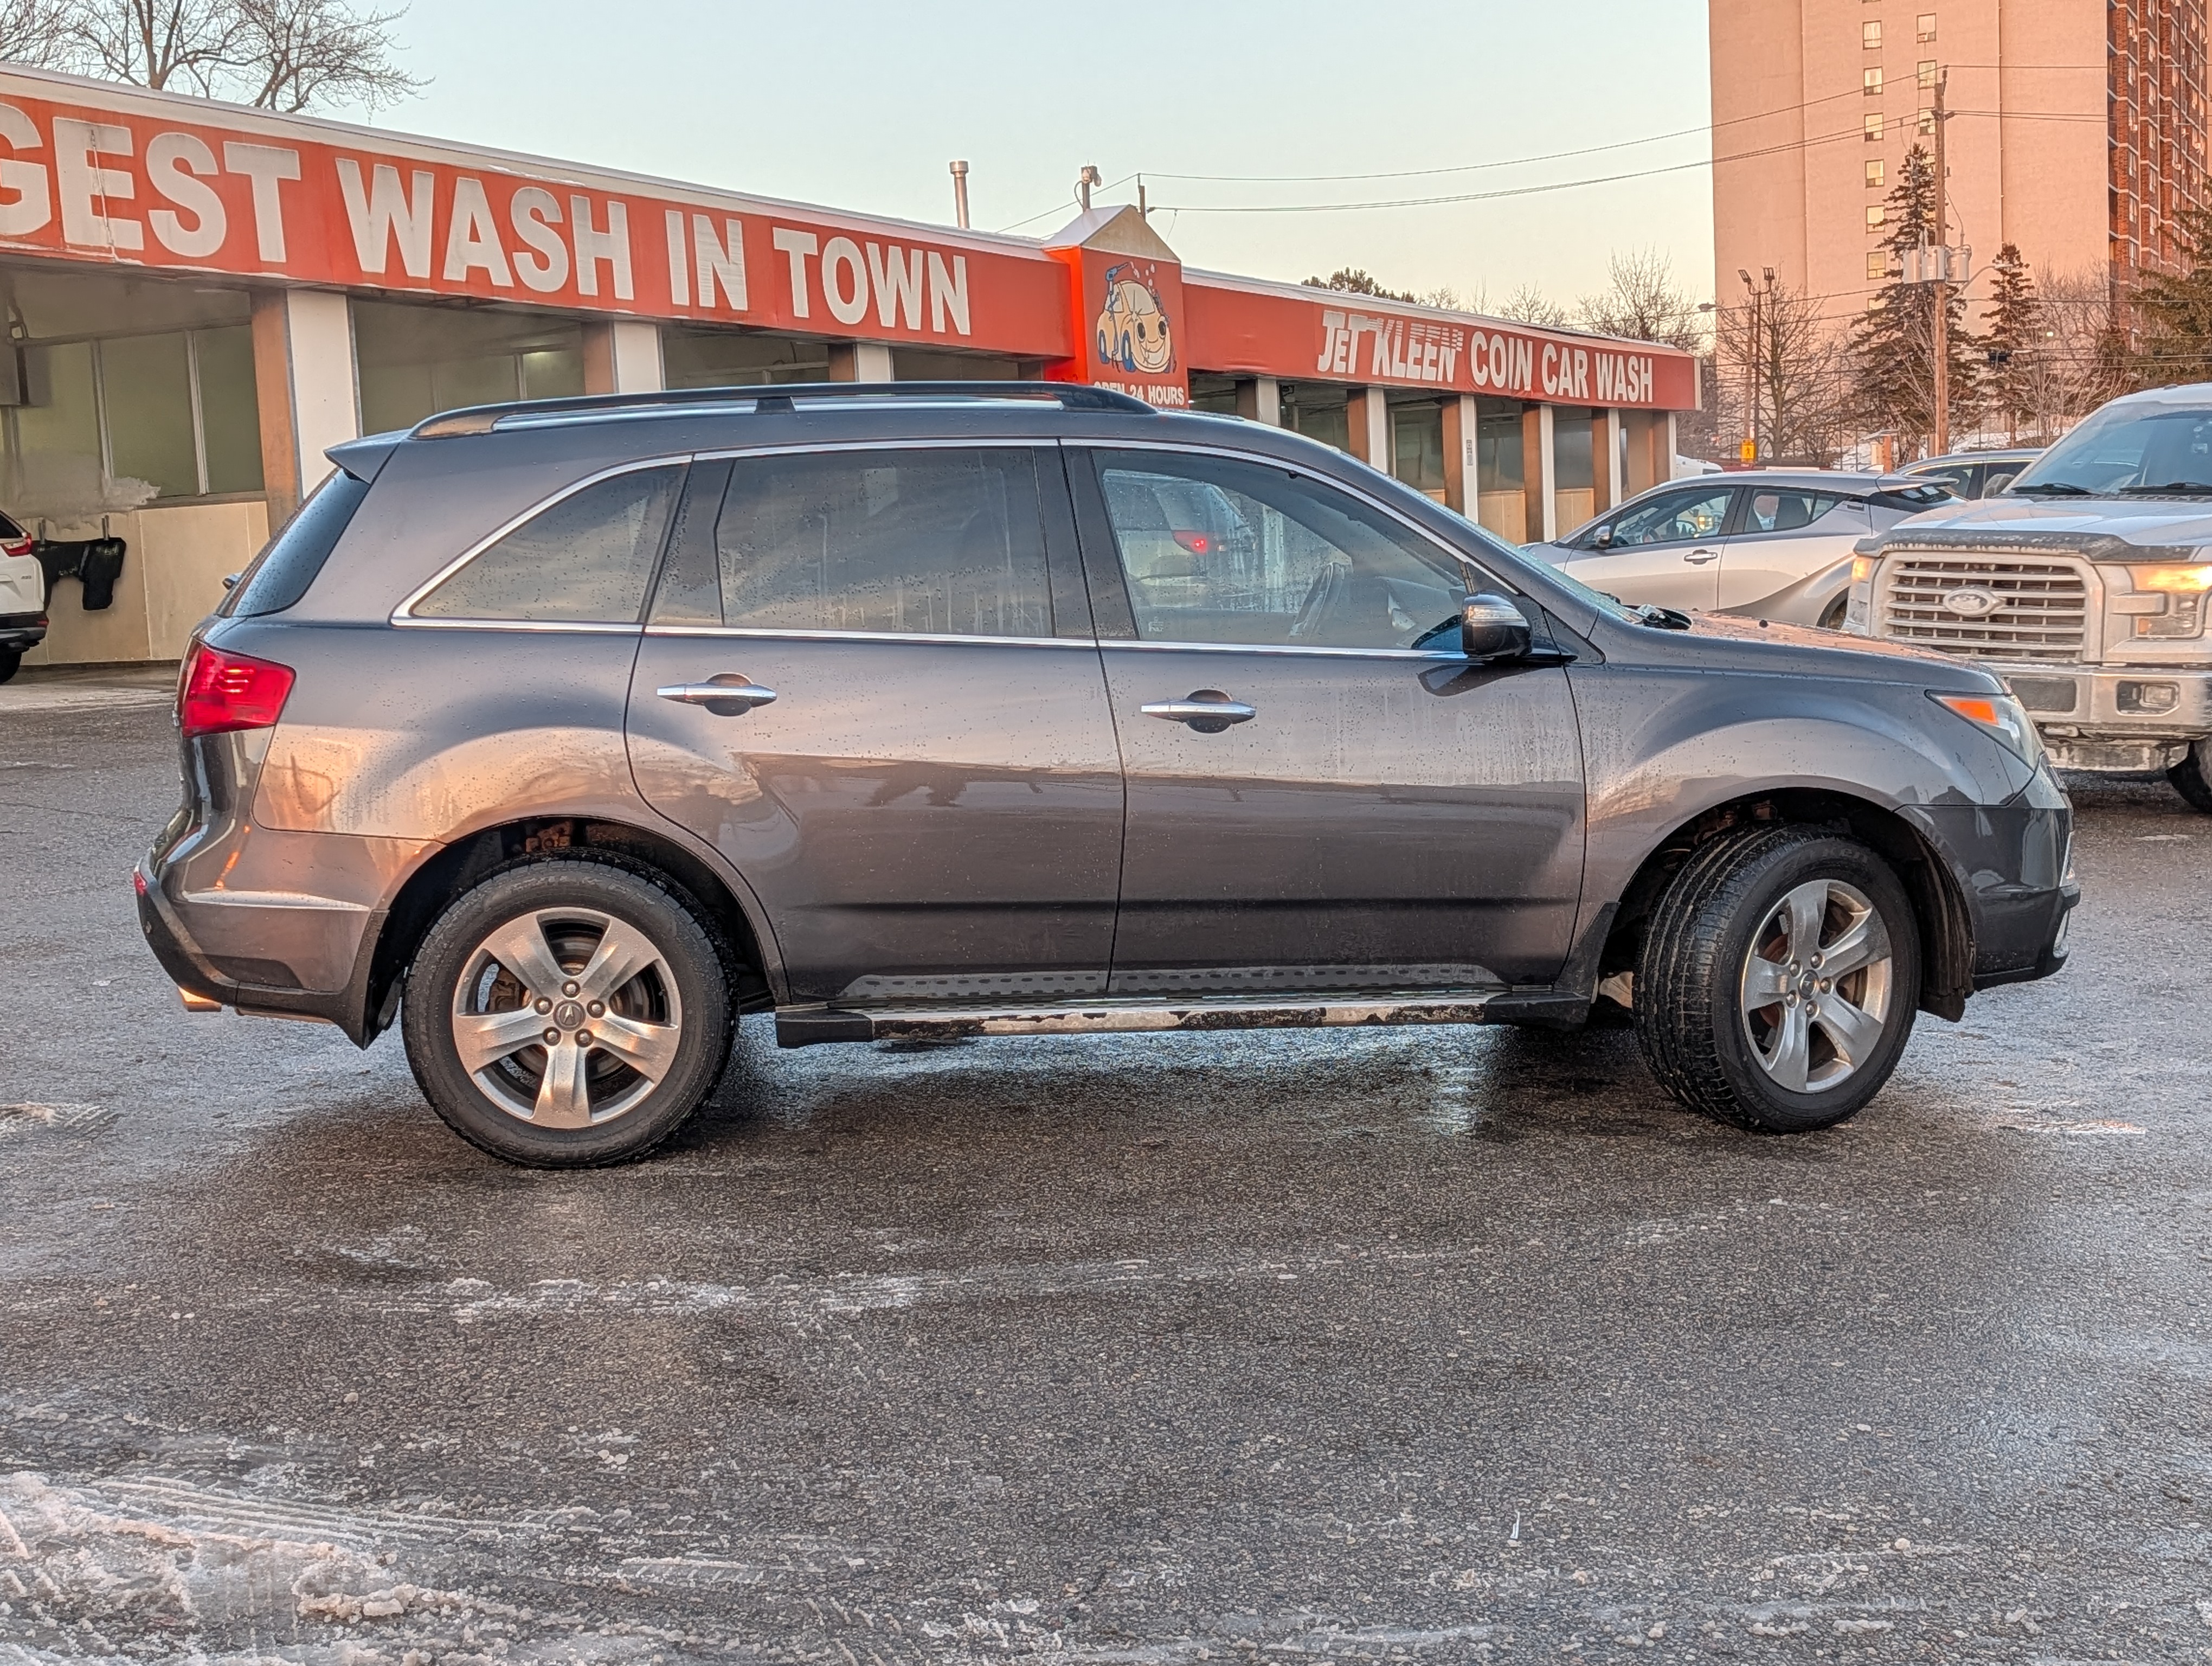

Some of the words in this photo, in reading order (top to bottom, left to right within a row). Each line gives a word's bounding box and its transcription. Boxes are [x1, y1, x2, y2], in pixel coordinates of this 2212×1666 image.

[335, 157, 634, 300] WASH
[665, 209, 748, 311] IN
[773, 227, 971, 336] TOWN
[1148, 385, 1185, 405] HOURS
[1317, 310, 1368, 374] JET
[1372, 318, 1464, 382] KLEEN
[1471, 331, 1533, 391] COIN
[1542, 343, 1589, 399] CAR
[1595, 353, 1653, 403] WASH
